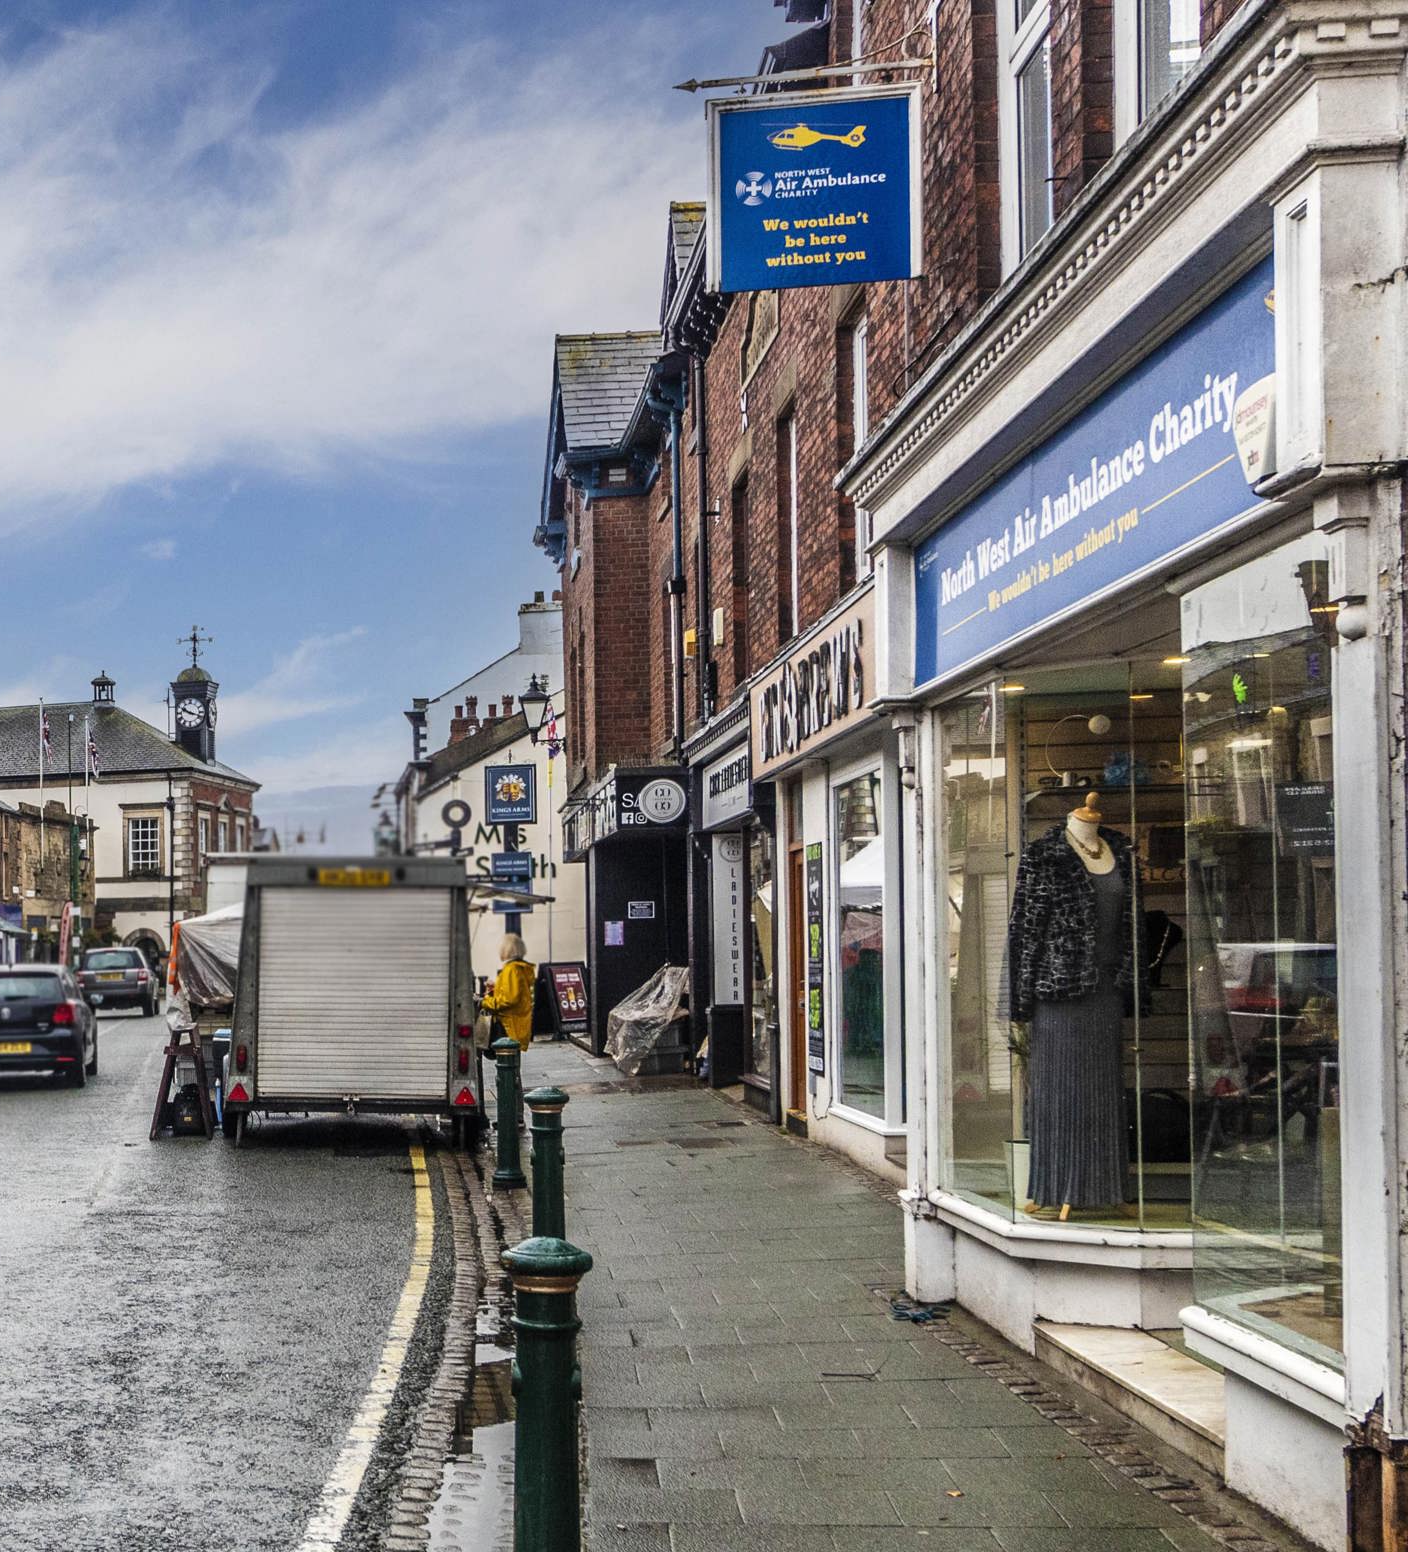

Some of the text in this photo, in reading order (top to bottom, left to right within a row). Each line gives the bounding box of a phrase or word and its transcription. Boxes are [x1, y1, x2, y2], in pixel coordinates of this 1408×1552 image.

[775, 167, 830, 179] NORTH WEST
[775, 172, 886, 191] Air Ambulance
[775, 189, 818, 199] CHARITY
[763, 212, 869, 231] We wouldn't
[785, 233, 847, 247] be here
[766, 249, 866, 267] without you
[941, 550, 976, 606] North
[977, 528, 1012, 580] West
[1013, 507, 1037, 557] Air
[1040, 439, 1145, 539] Ambulance
[1149, 372, 1238, 463] Charity
[988, 589, 1001, 612] We
[1038, 560, 1050, 580] be
[1052, 546, 1074, 576] here
[1075, 517, 1117, 562] without
[1117, 507, 1139, 543] you
[730, 867, 739, 1001] LADIESWEAR
